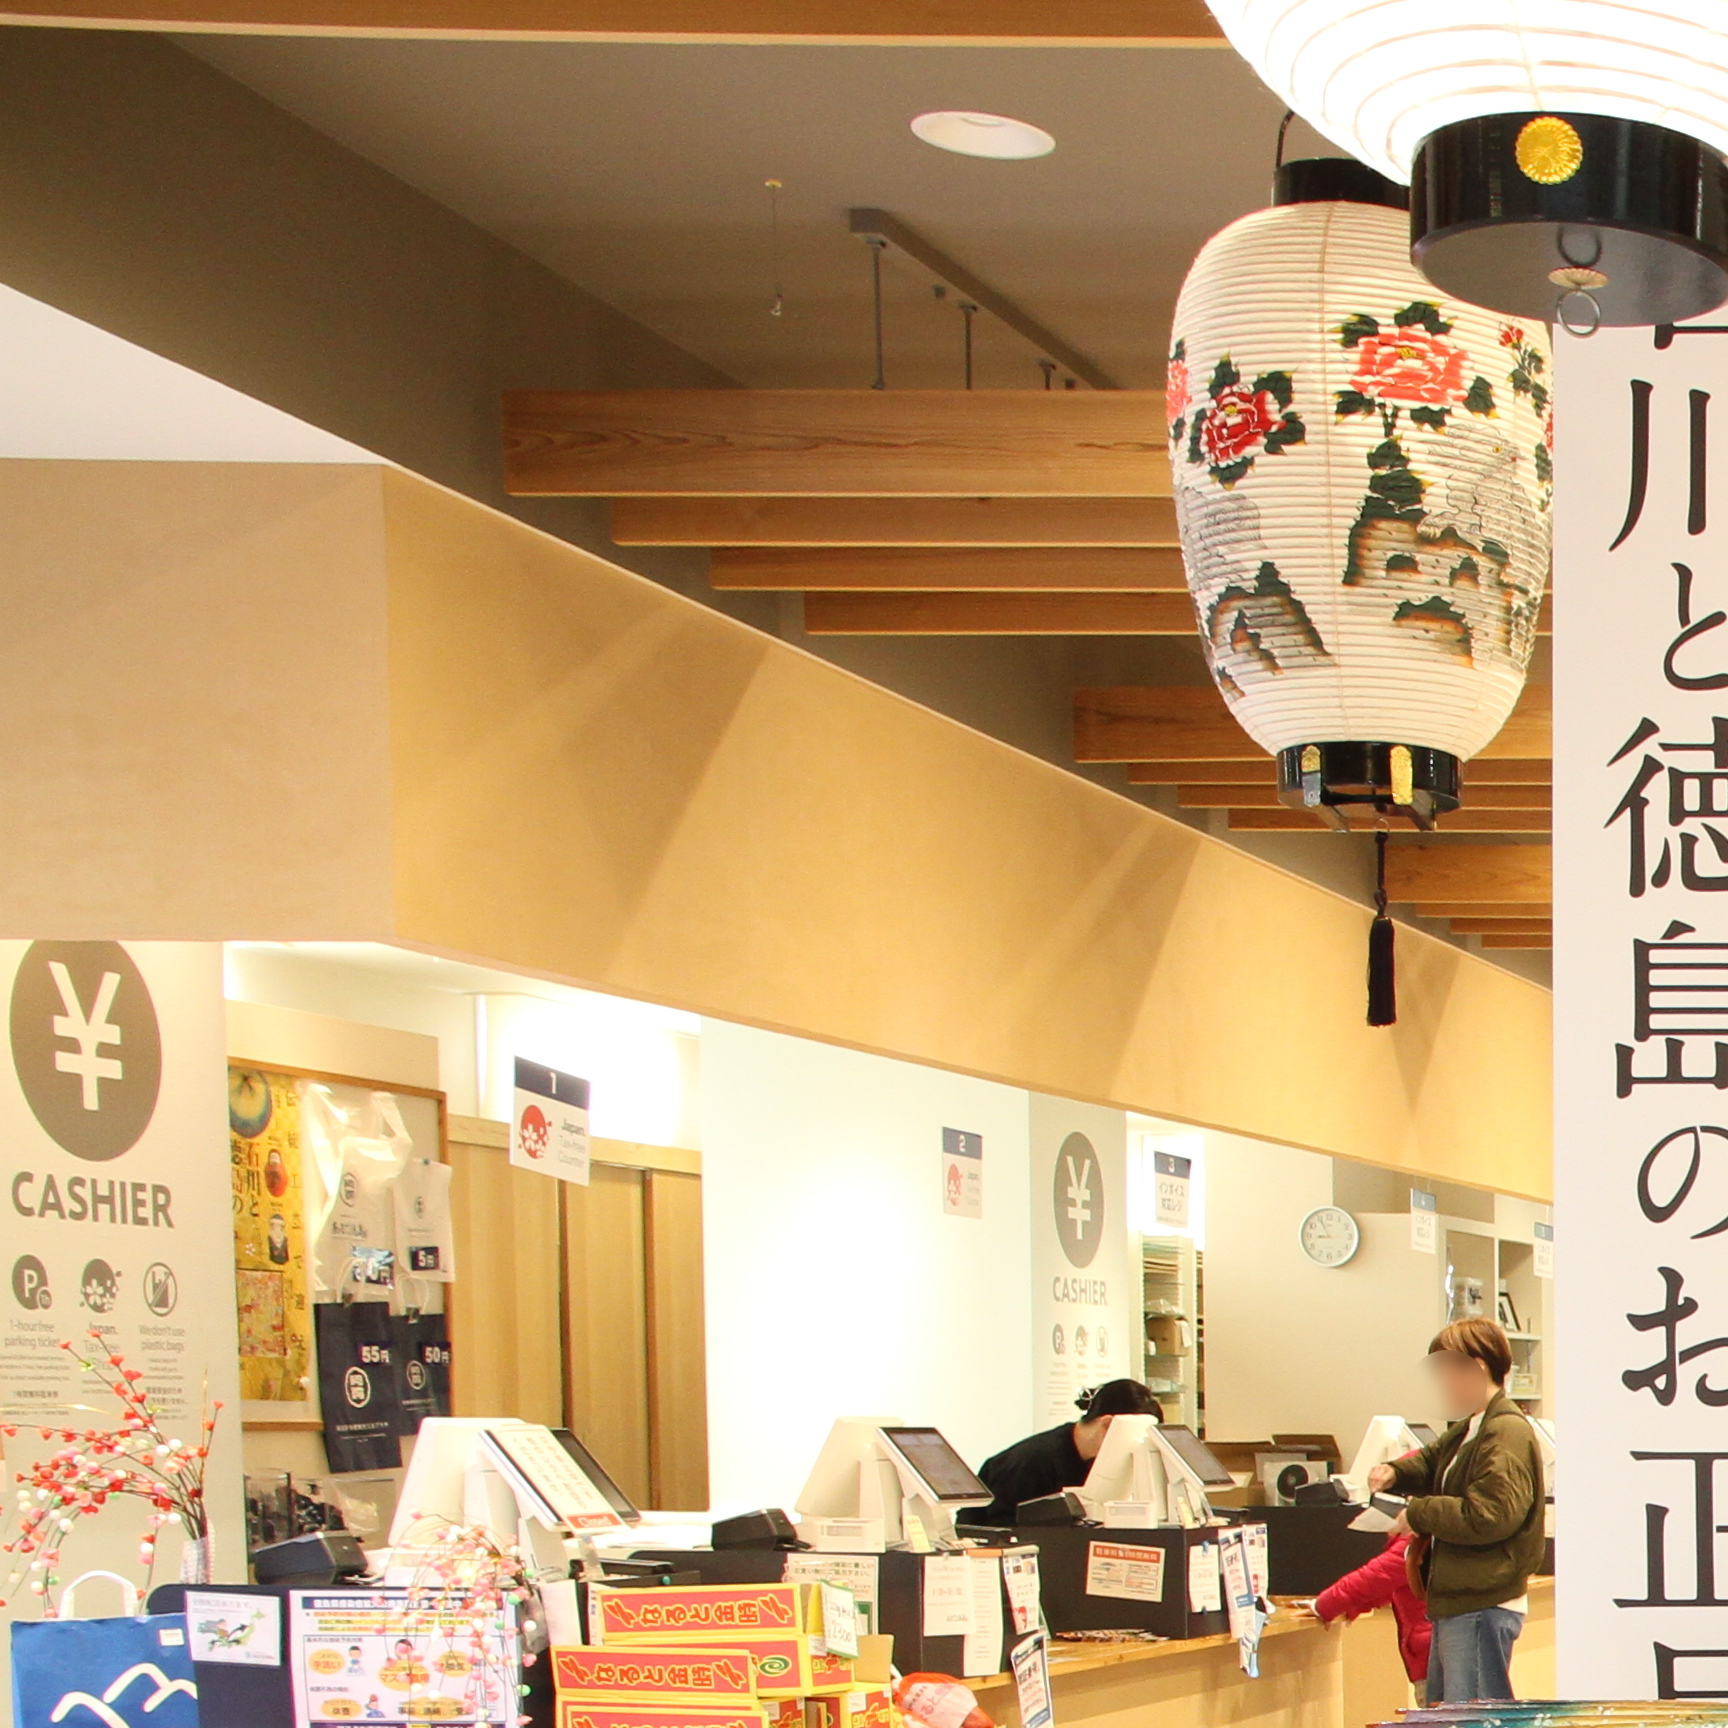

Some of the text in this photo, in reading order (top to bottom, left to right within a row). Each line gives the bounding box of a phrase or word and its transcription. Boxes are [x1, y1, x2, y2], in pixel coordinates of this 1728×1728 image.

[550, 1072, 557, 1094] 1
[959, 1135, 966, 1152] 2
[11, 1171, 175, 1228] CASHIER
[1052, 1276, 1108, 1306] CASHIER
[362, 1346, 390, 1363] 55円
